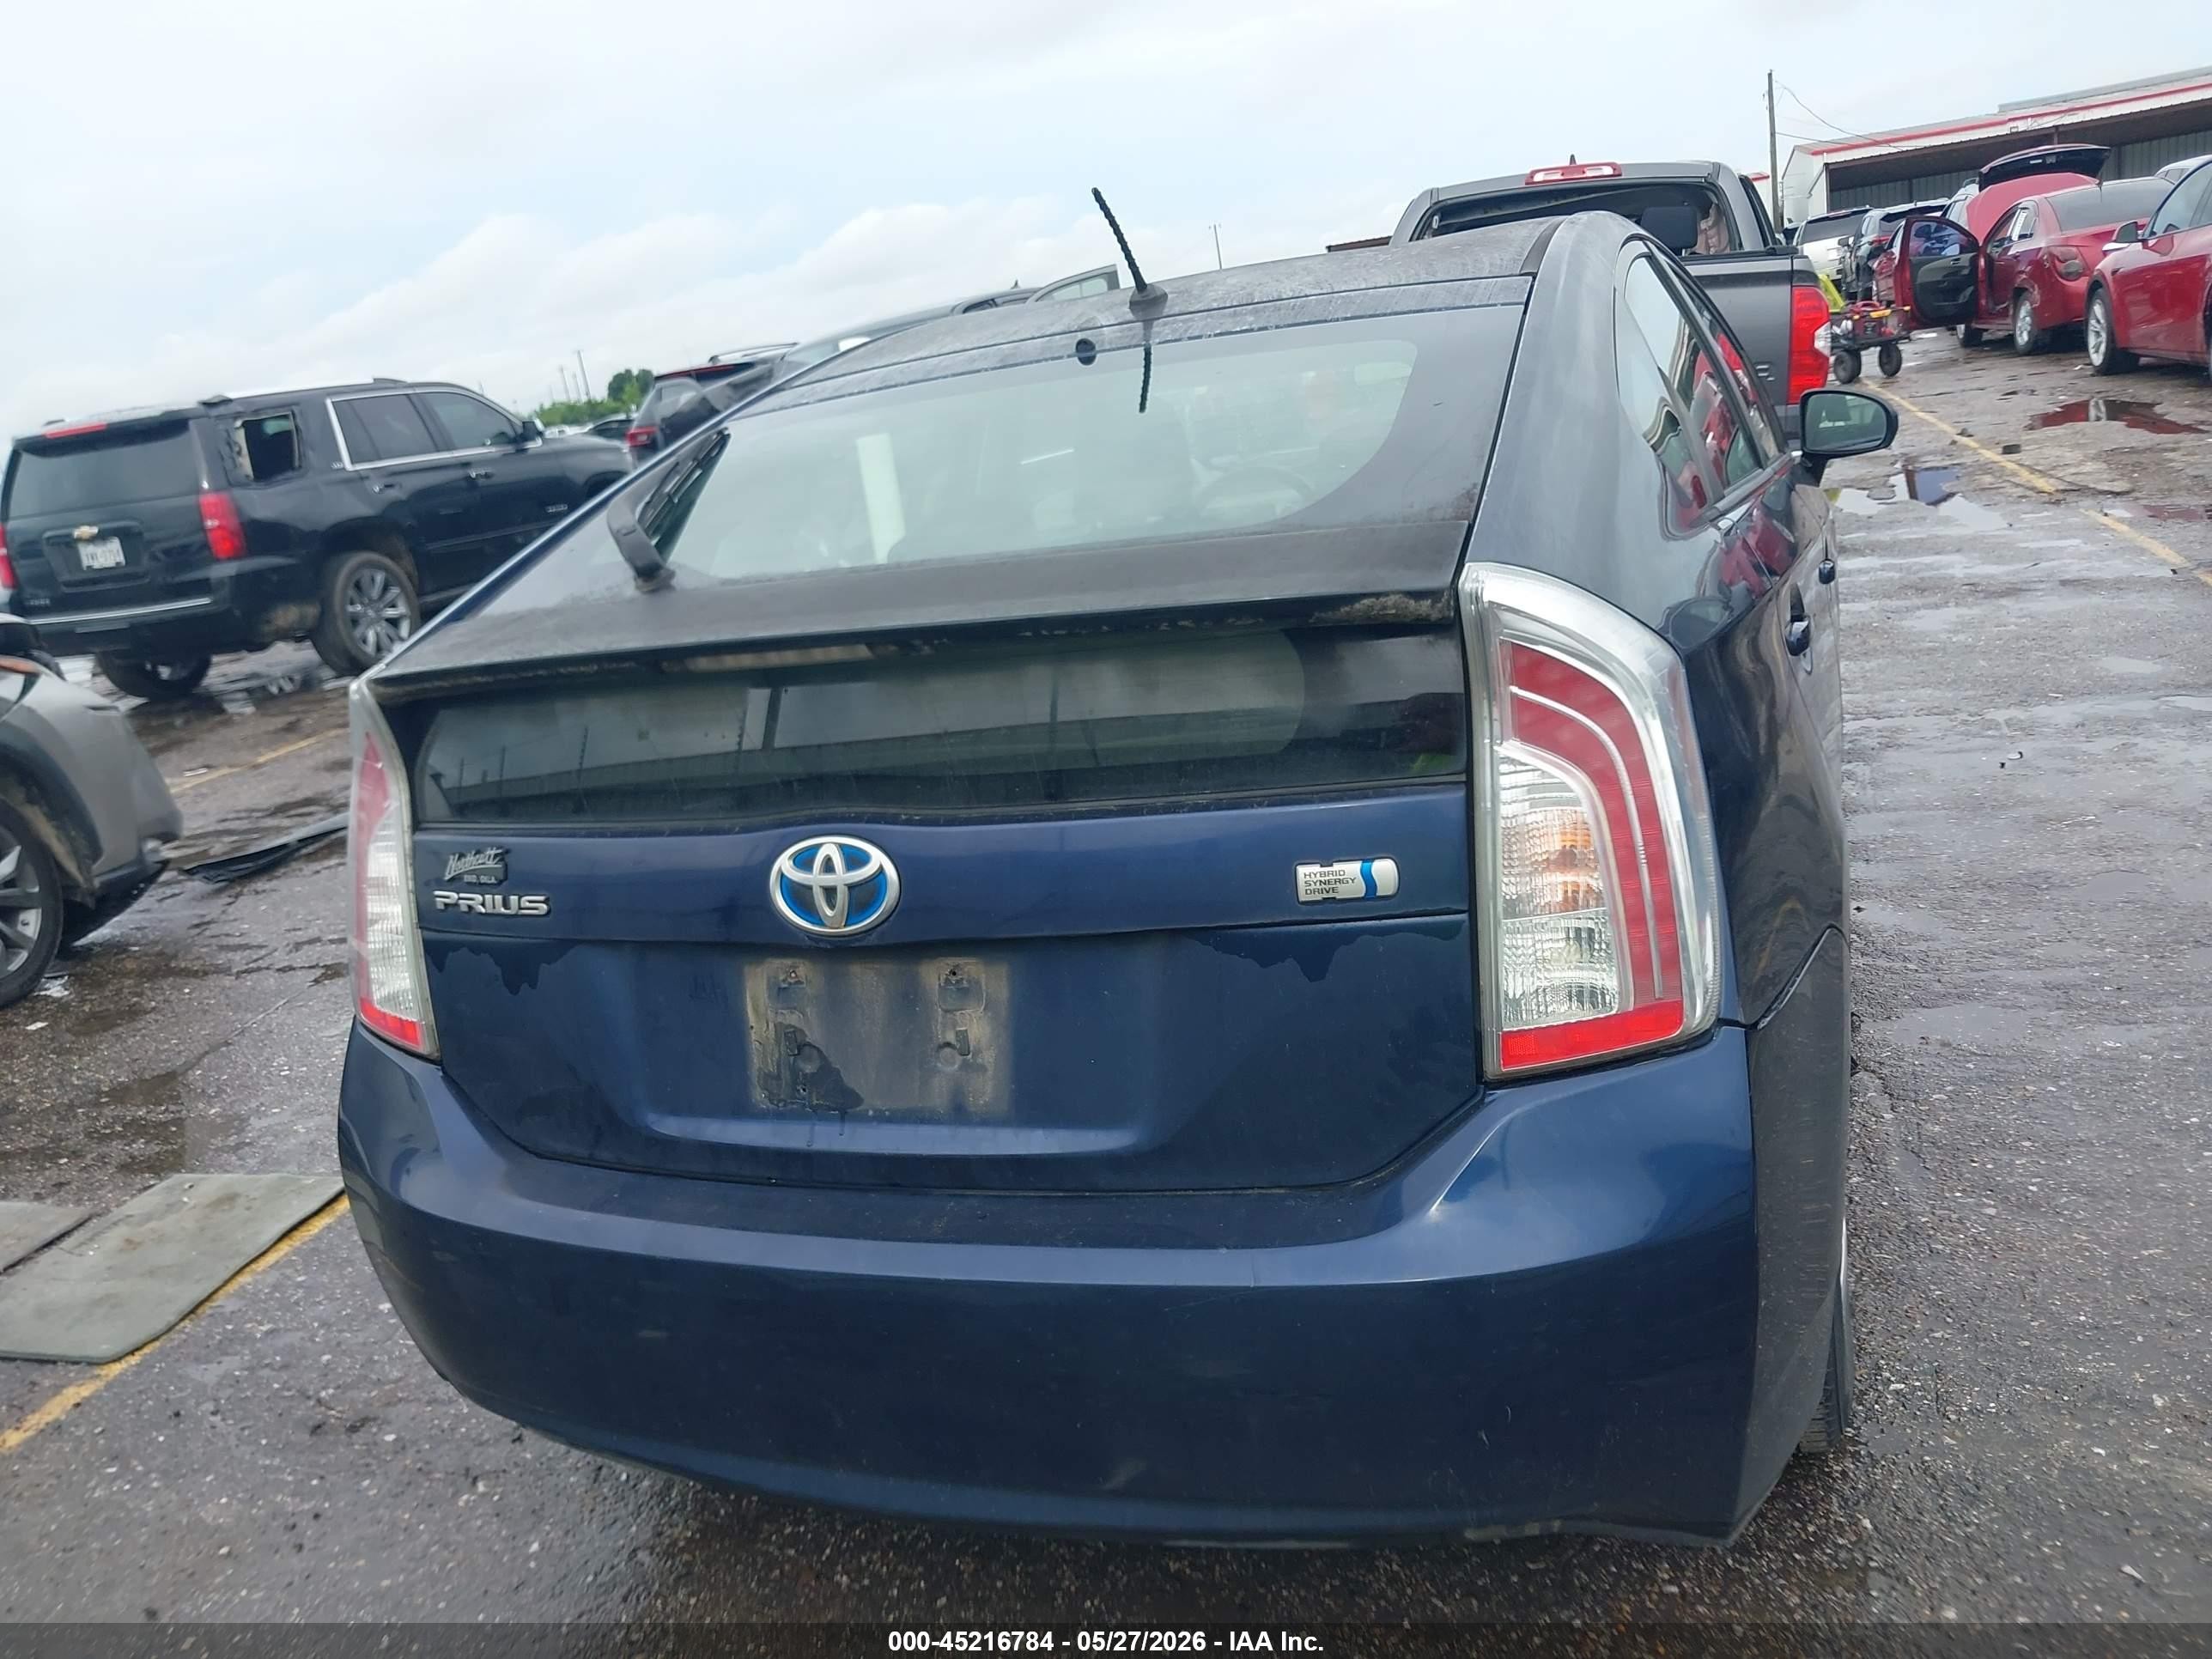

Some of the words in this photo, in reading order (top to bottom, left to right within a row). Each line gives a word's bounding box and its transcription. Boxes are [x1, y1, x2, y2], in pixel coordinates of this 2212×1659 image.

[1304, 869, 1346, 879] HYBRID
[1304, 878, 1357, 887] SYNERGY
[1305, 886, 1340, 896] DRIVE
[433, 890, 549, 916] PRIUS
